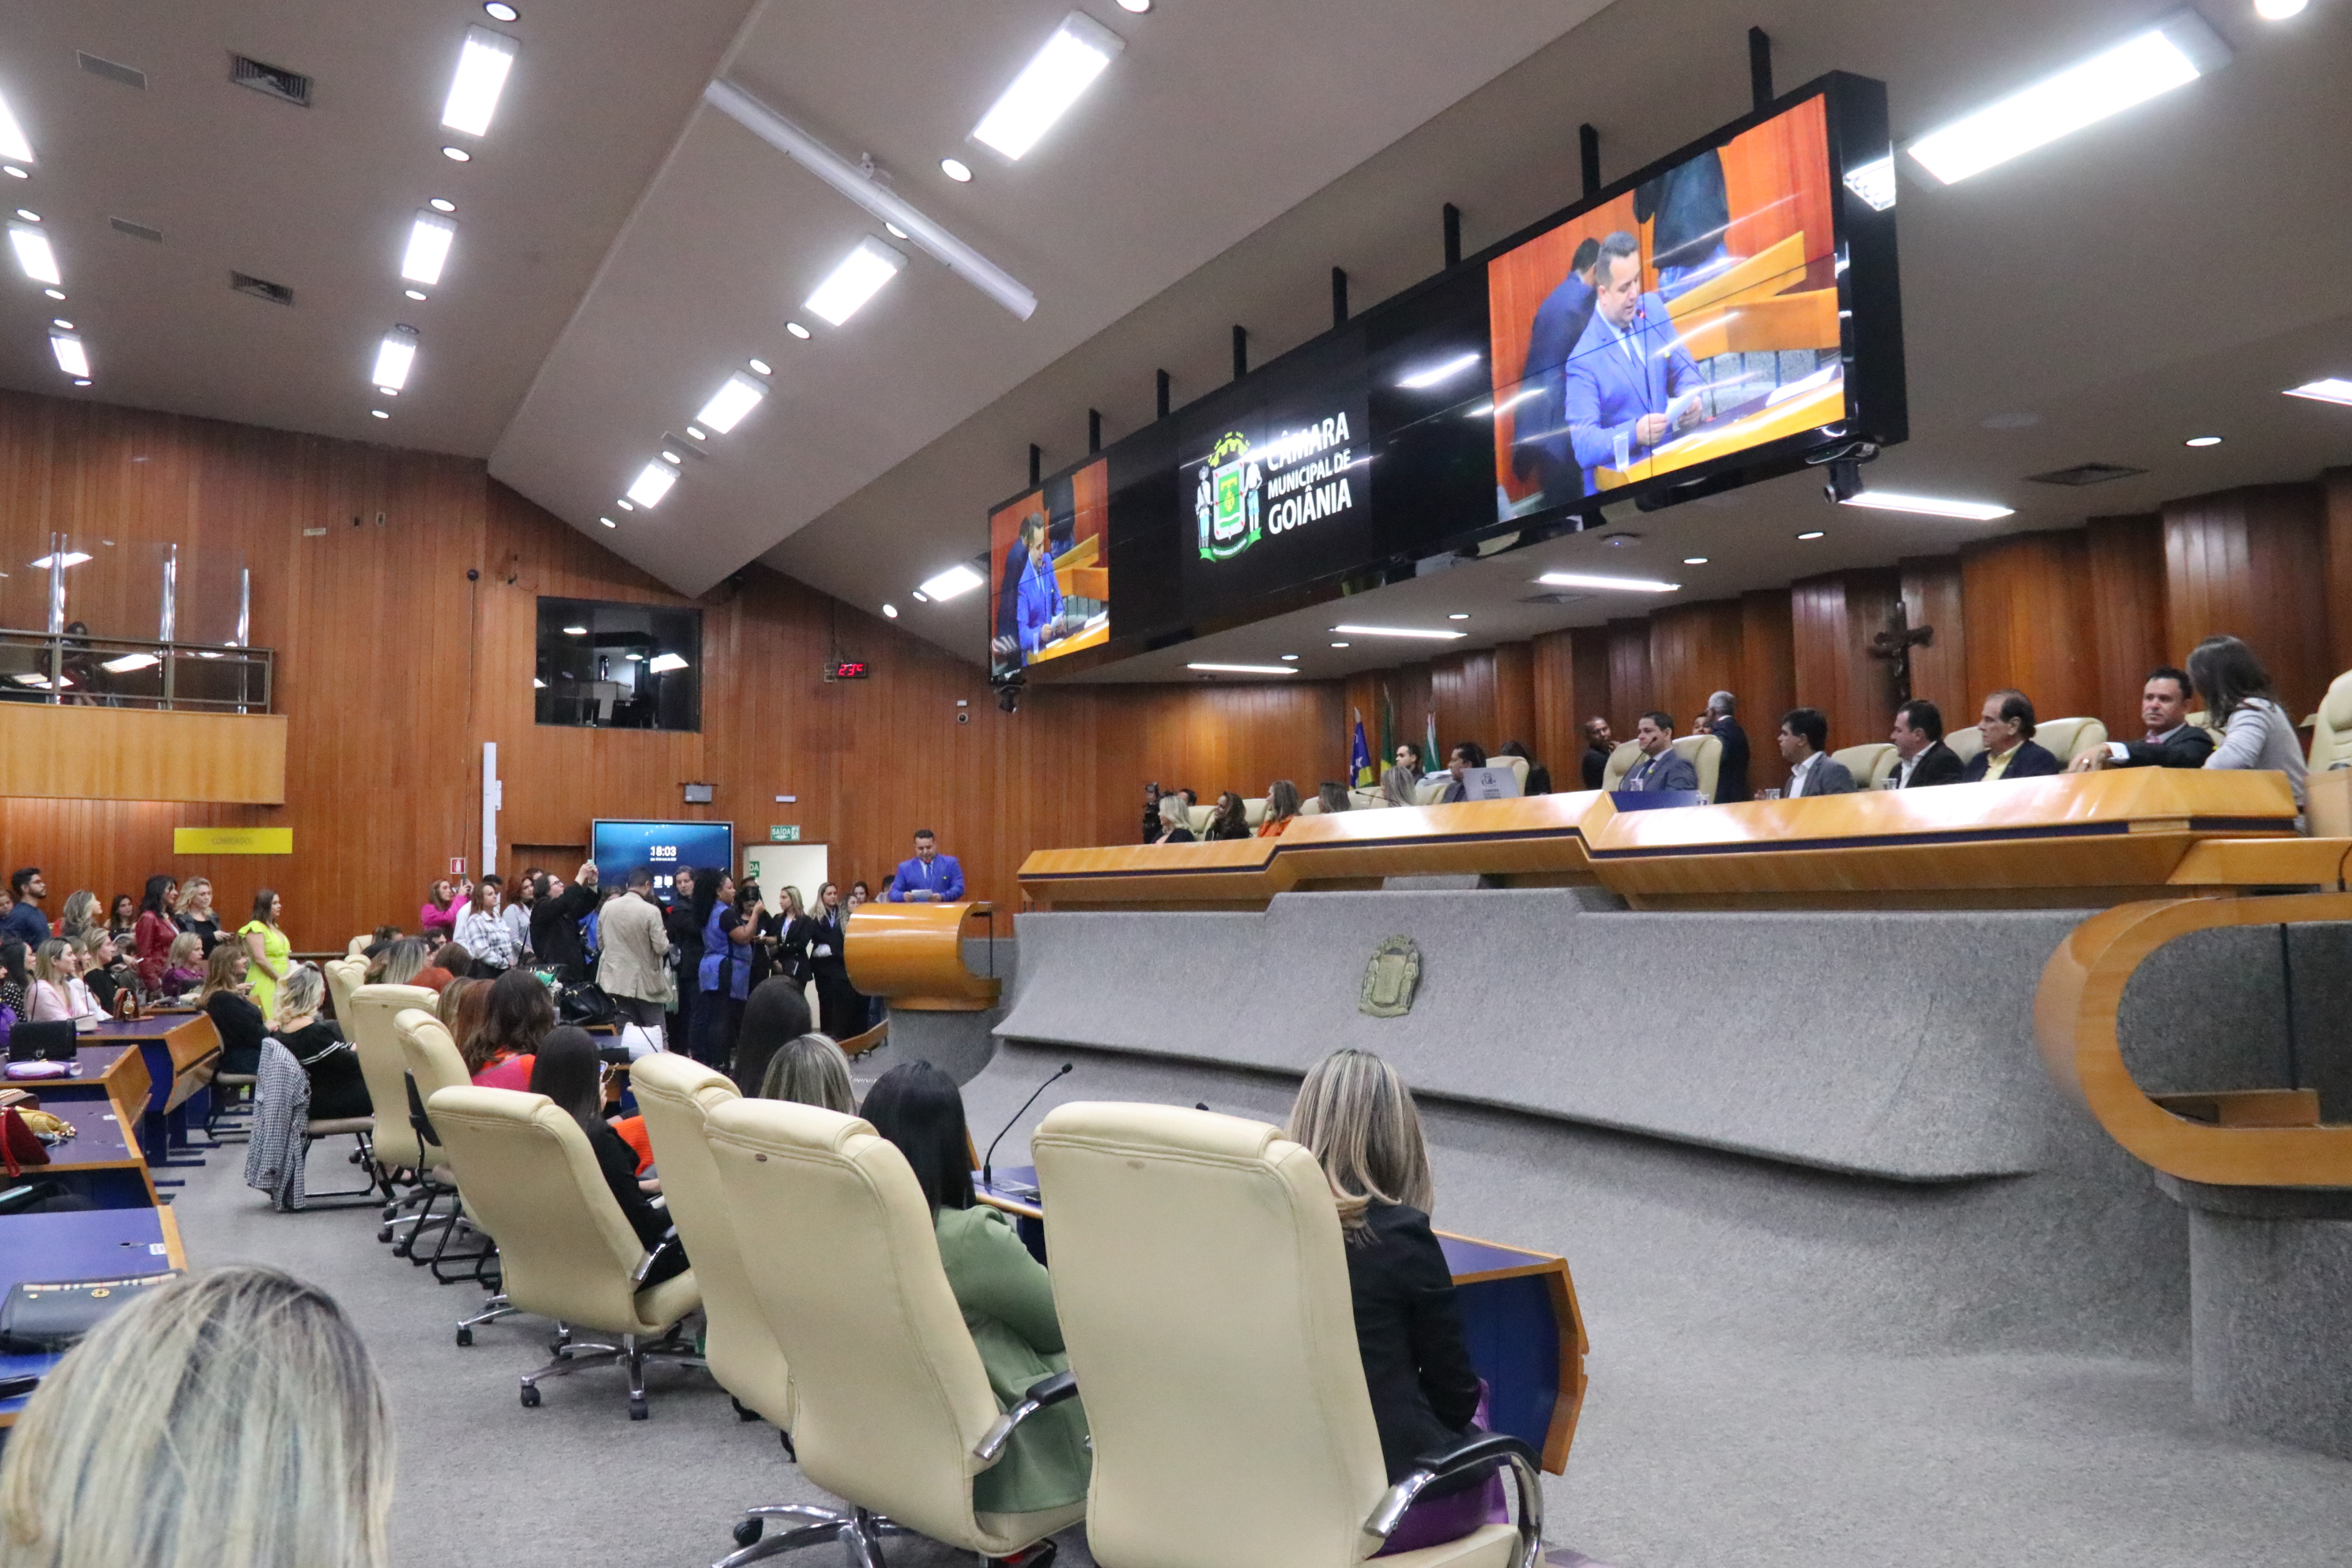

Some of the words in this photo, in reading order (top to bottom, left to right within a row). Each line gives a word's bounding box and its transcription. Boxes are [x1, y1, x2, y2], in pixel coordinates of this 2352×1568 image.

[1266, 411, 1350, 471] CÂMARA
[1268, 457, 1333, 500] MUNICIPAL
[1333, 447, 1351, 474] DE
[1268, 477, 1352, 535] GOIÂNIA
[650, 846, 677, 857] 18:03
[771, 827, 791, 835] SAÍDA
